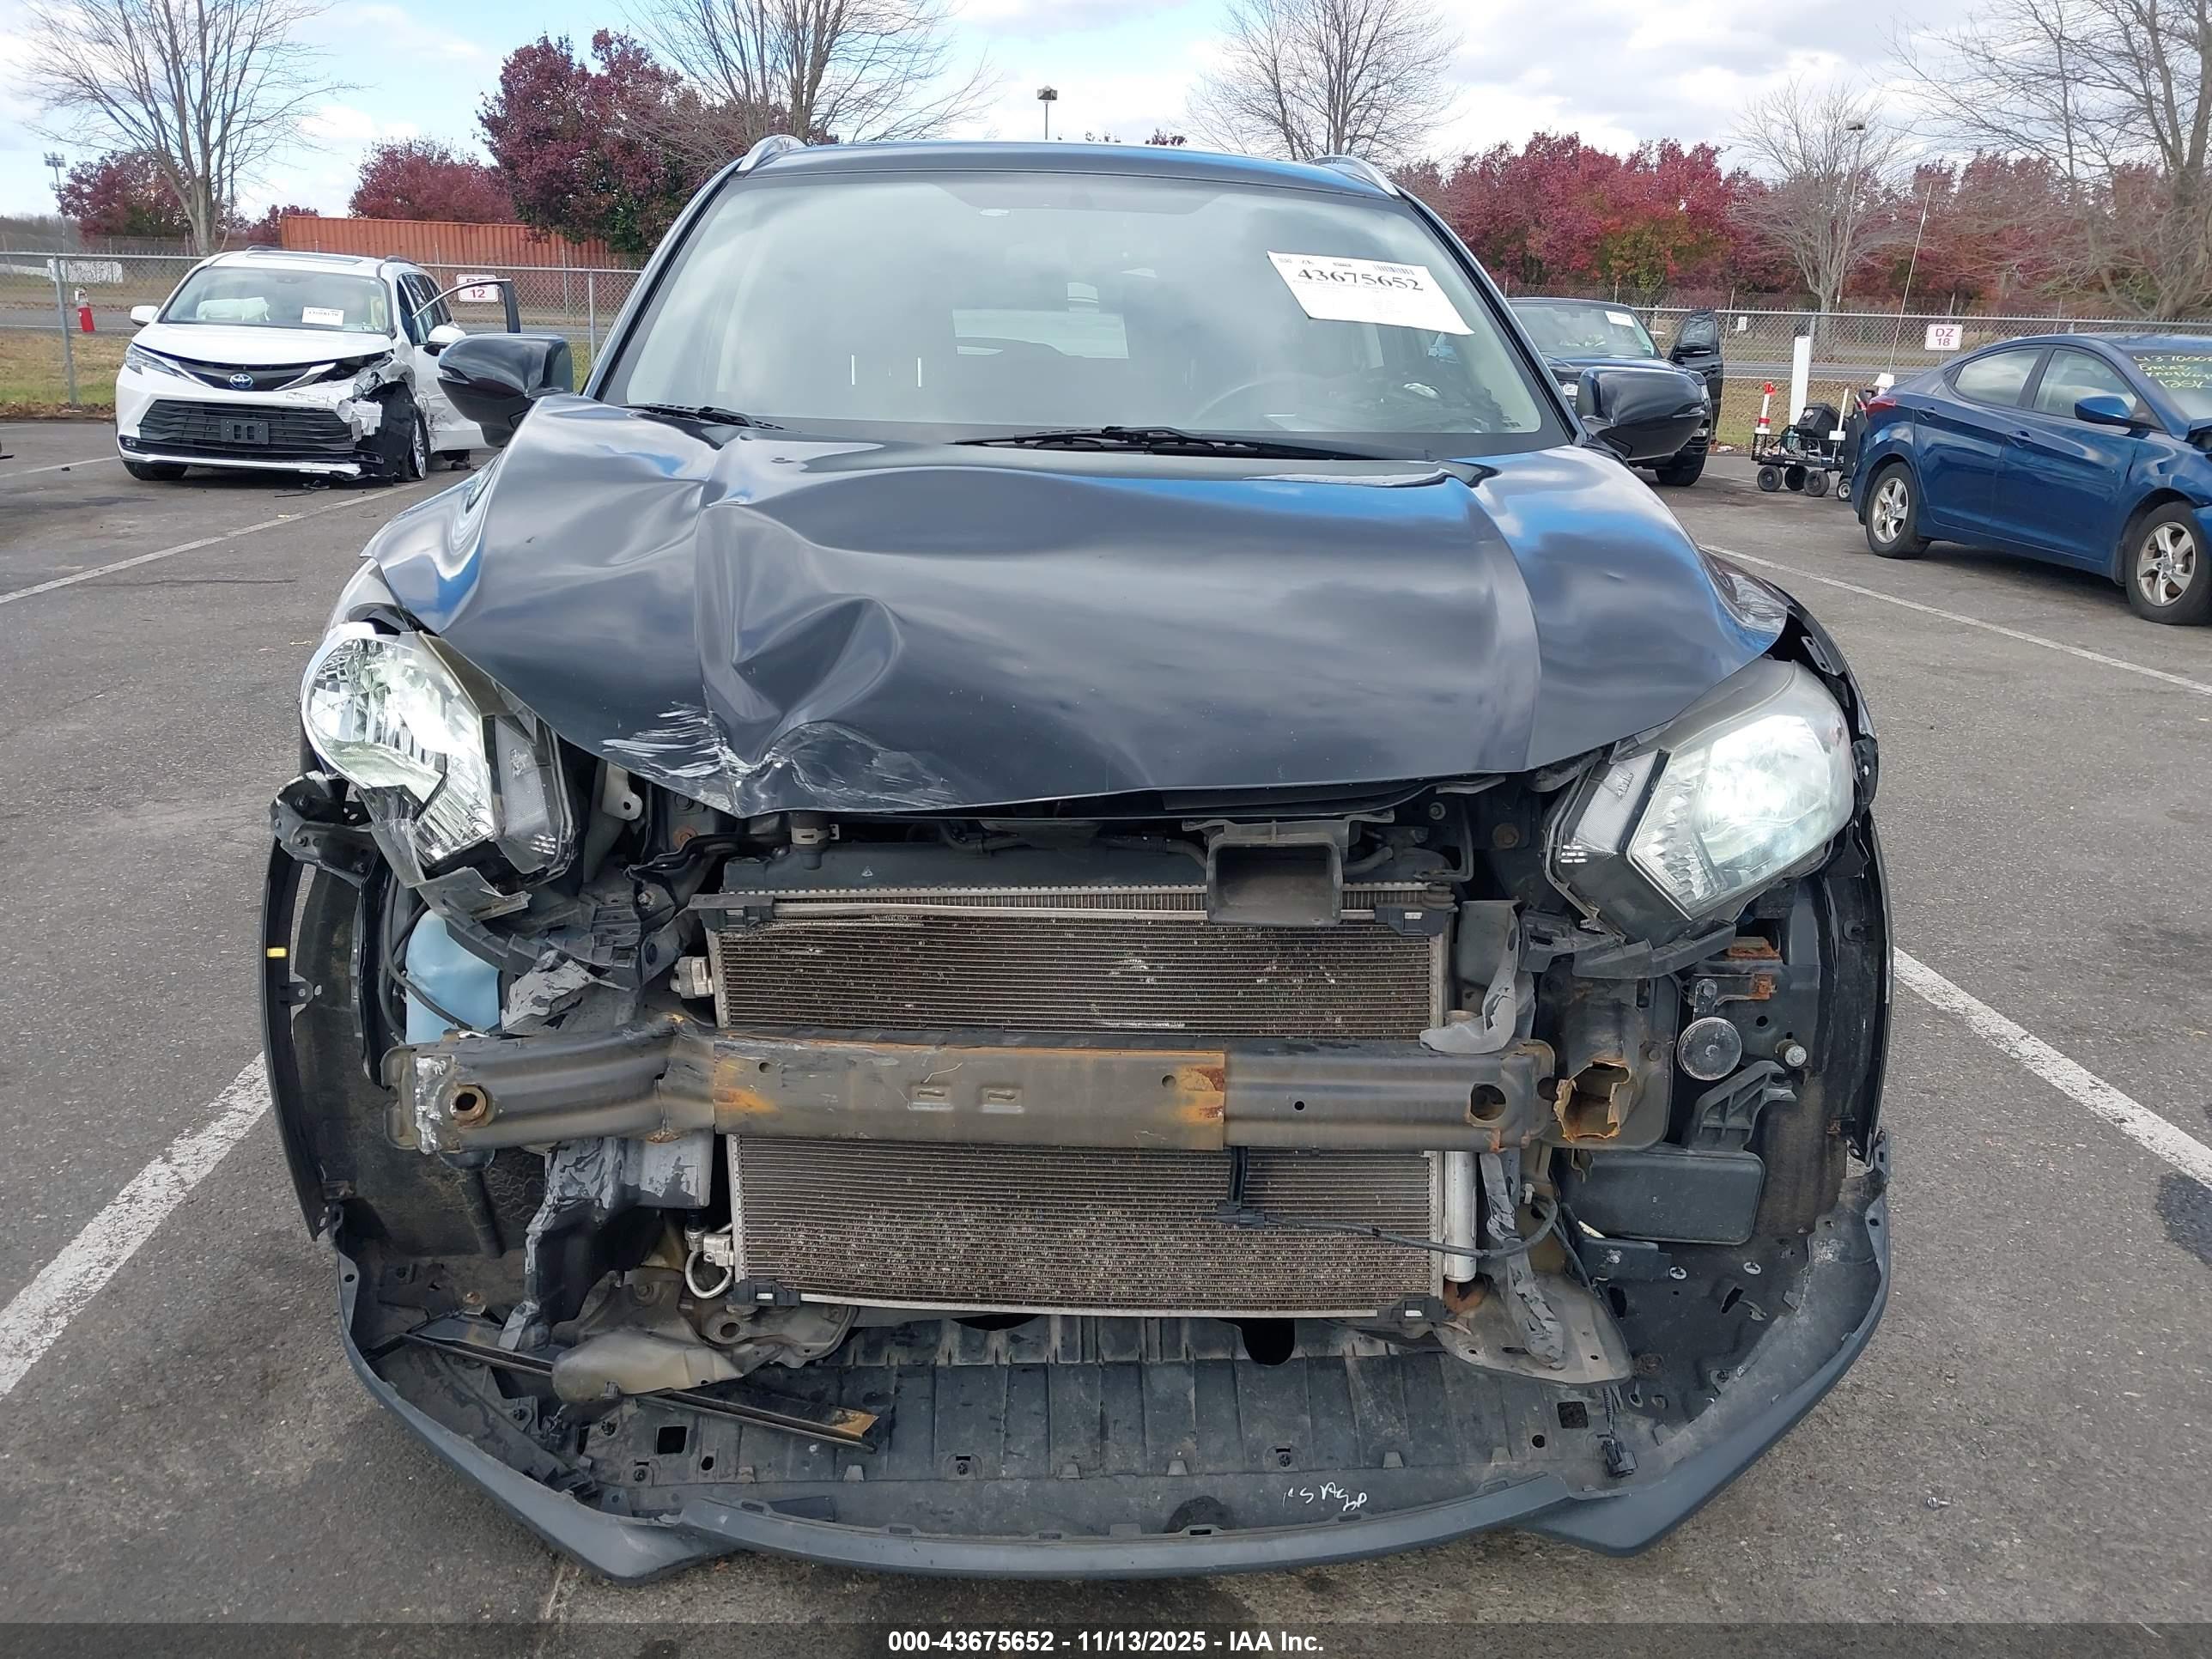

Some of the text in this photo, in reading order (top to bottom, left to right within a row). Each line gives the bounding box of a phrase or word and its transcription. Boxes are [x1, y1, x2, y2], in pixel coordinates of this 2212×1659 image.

[1297, 268, 1424, 291] 43675652
[470, 289, 486, 299] 12
[1936, 328, 1954, 337] DZ
[1936, 337, 1951, 346] 18
